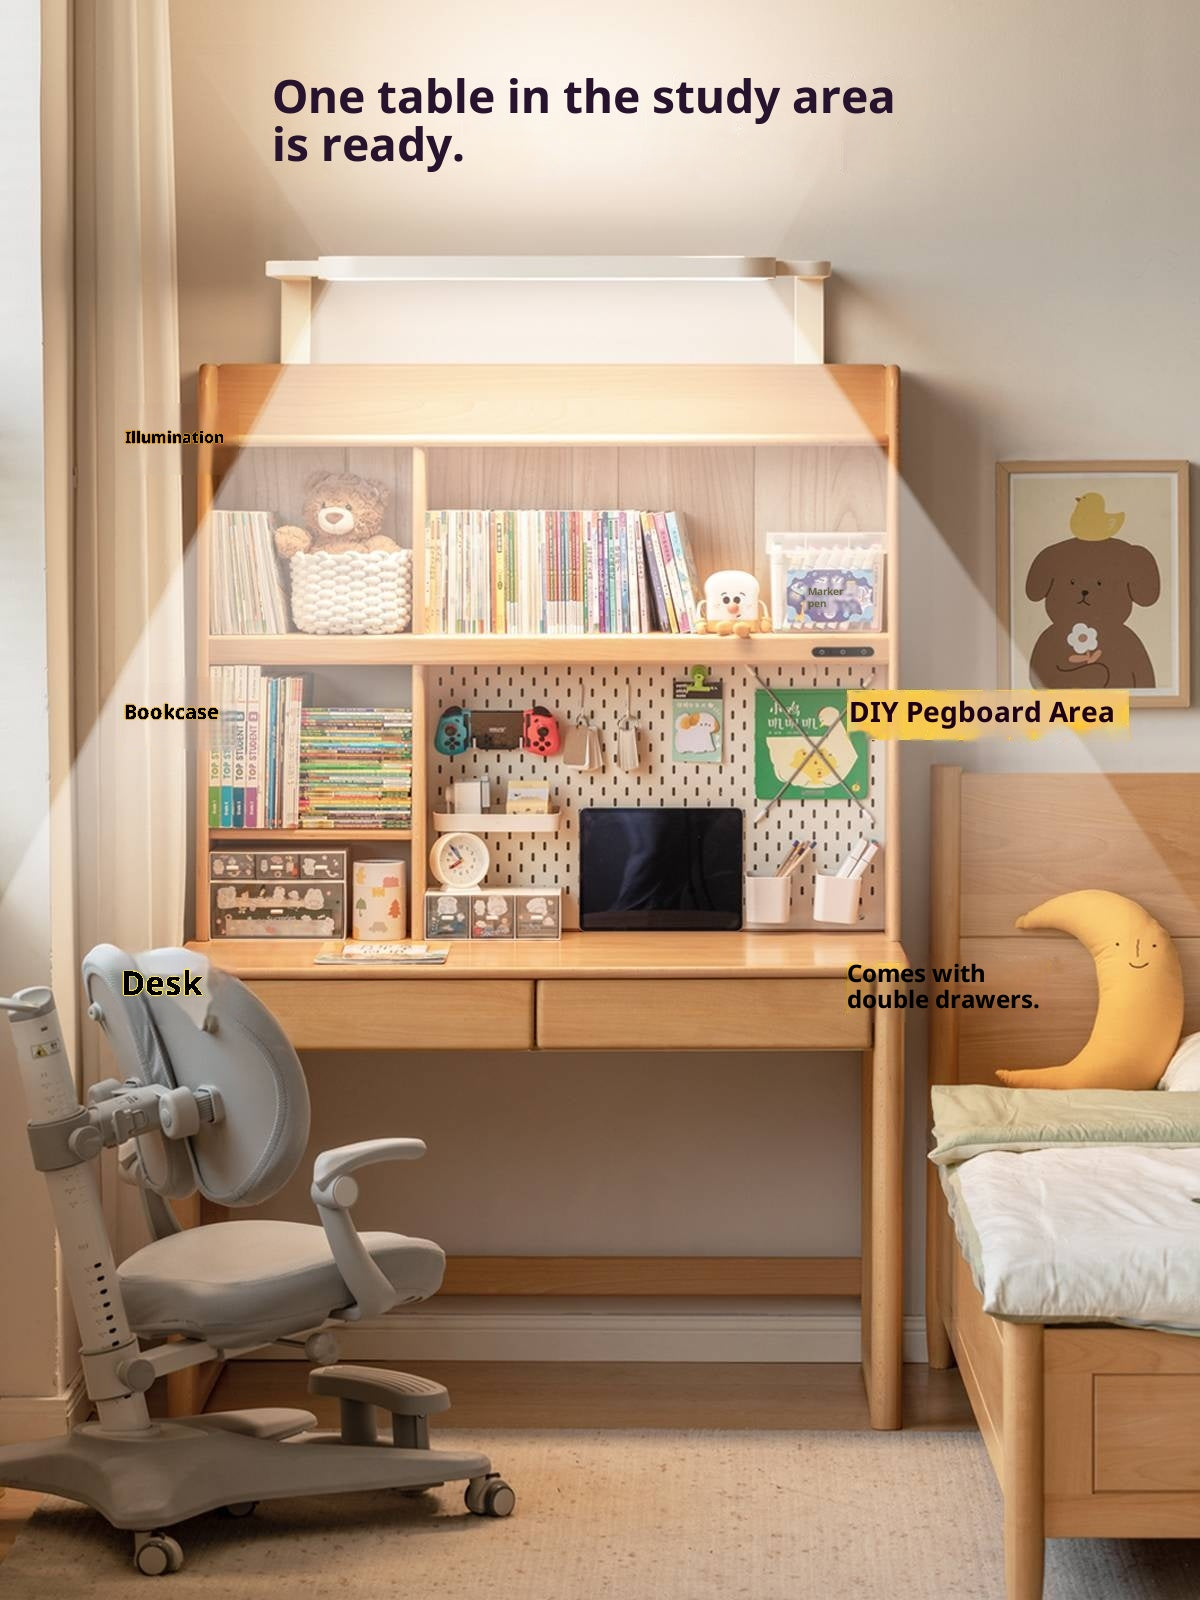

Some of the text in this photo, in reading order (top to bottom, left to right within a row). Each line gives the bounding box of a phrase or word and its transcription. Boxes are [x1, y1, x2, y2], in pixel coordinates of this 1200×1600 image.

[236, 725, 244, 761] STUDENT
[248, 725, 257, 761] STUDENT
[235, 763, 244, 781] TOP
[248, 763, 257, 781] TOP
